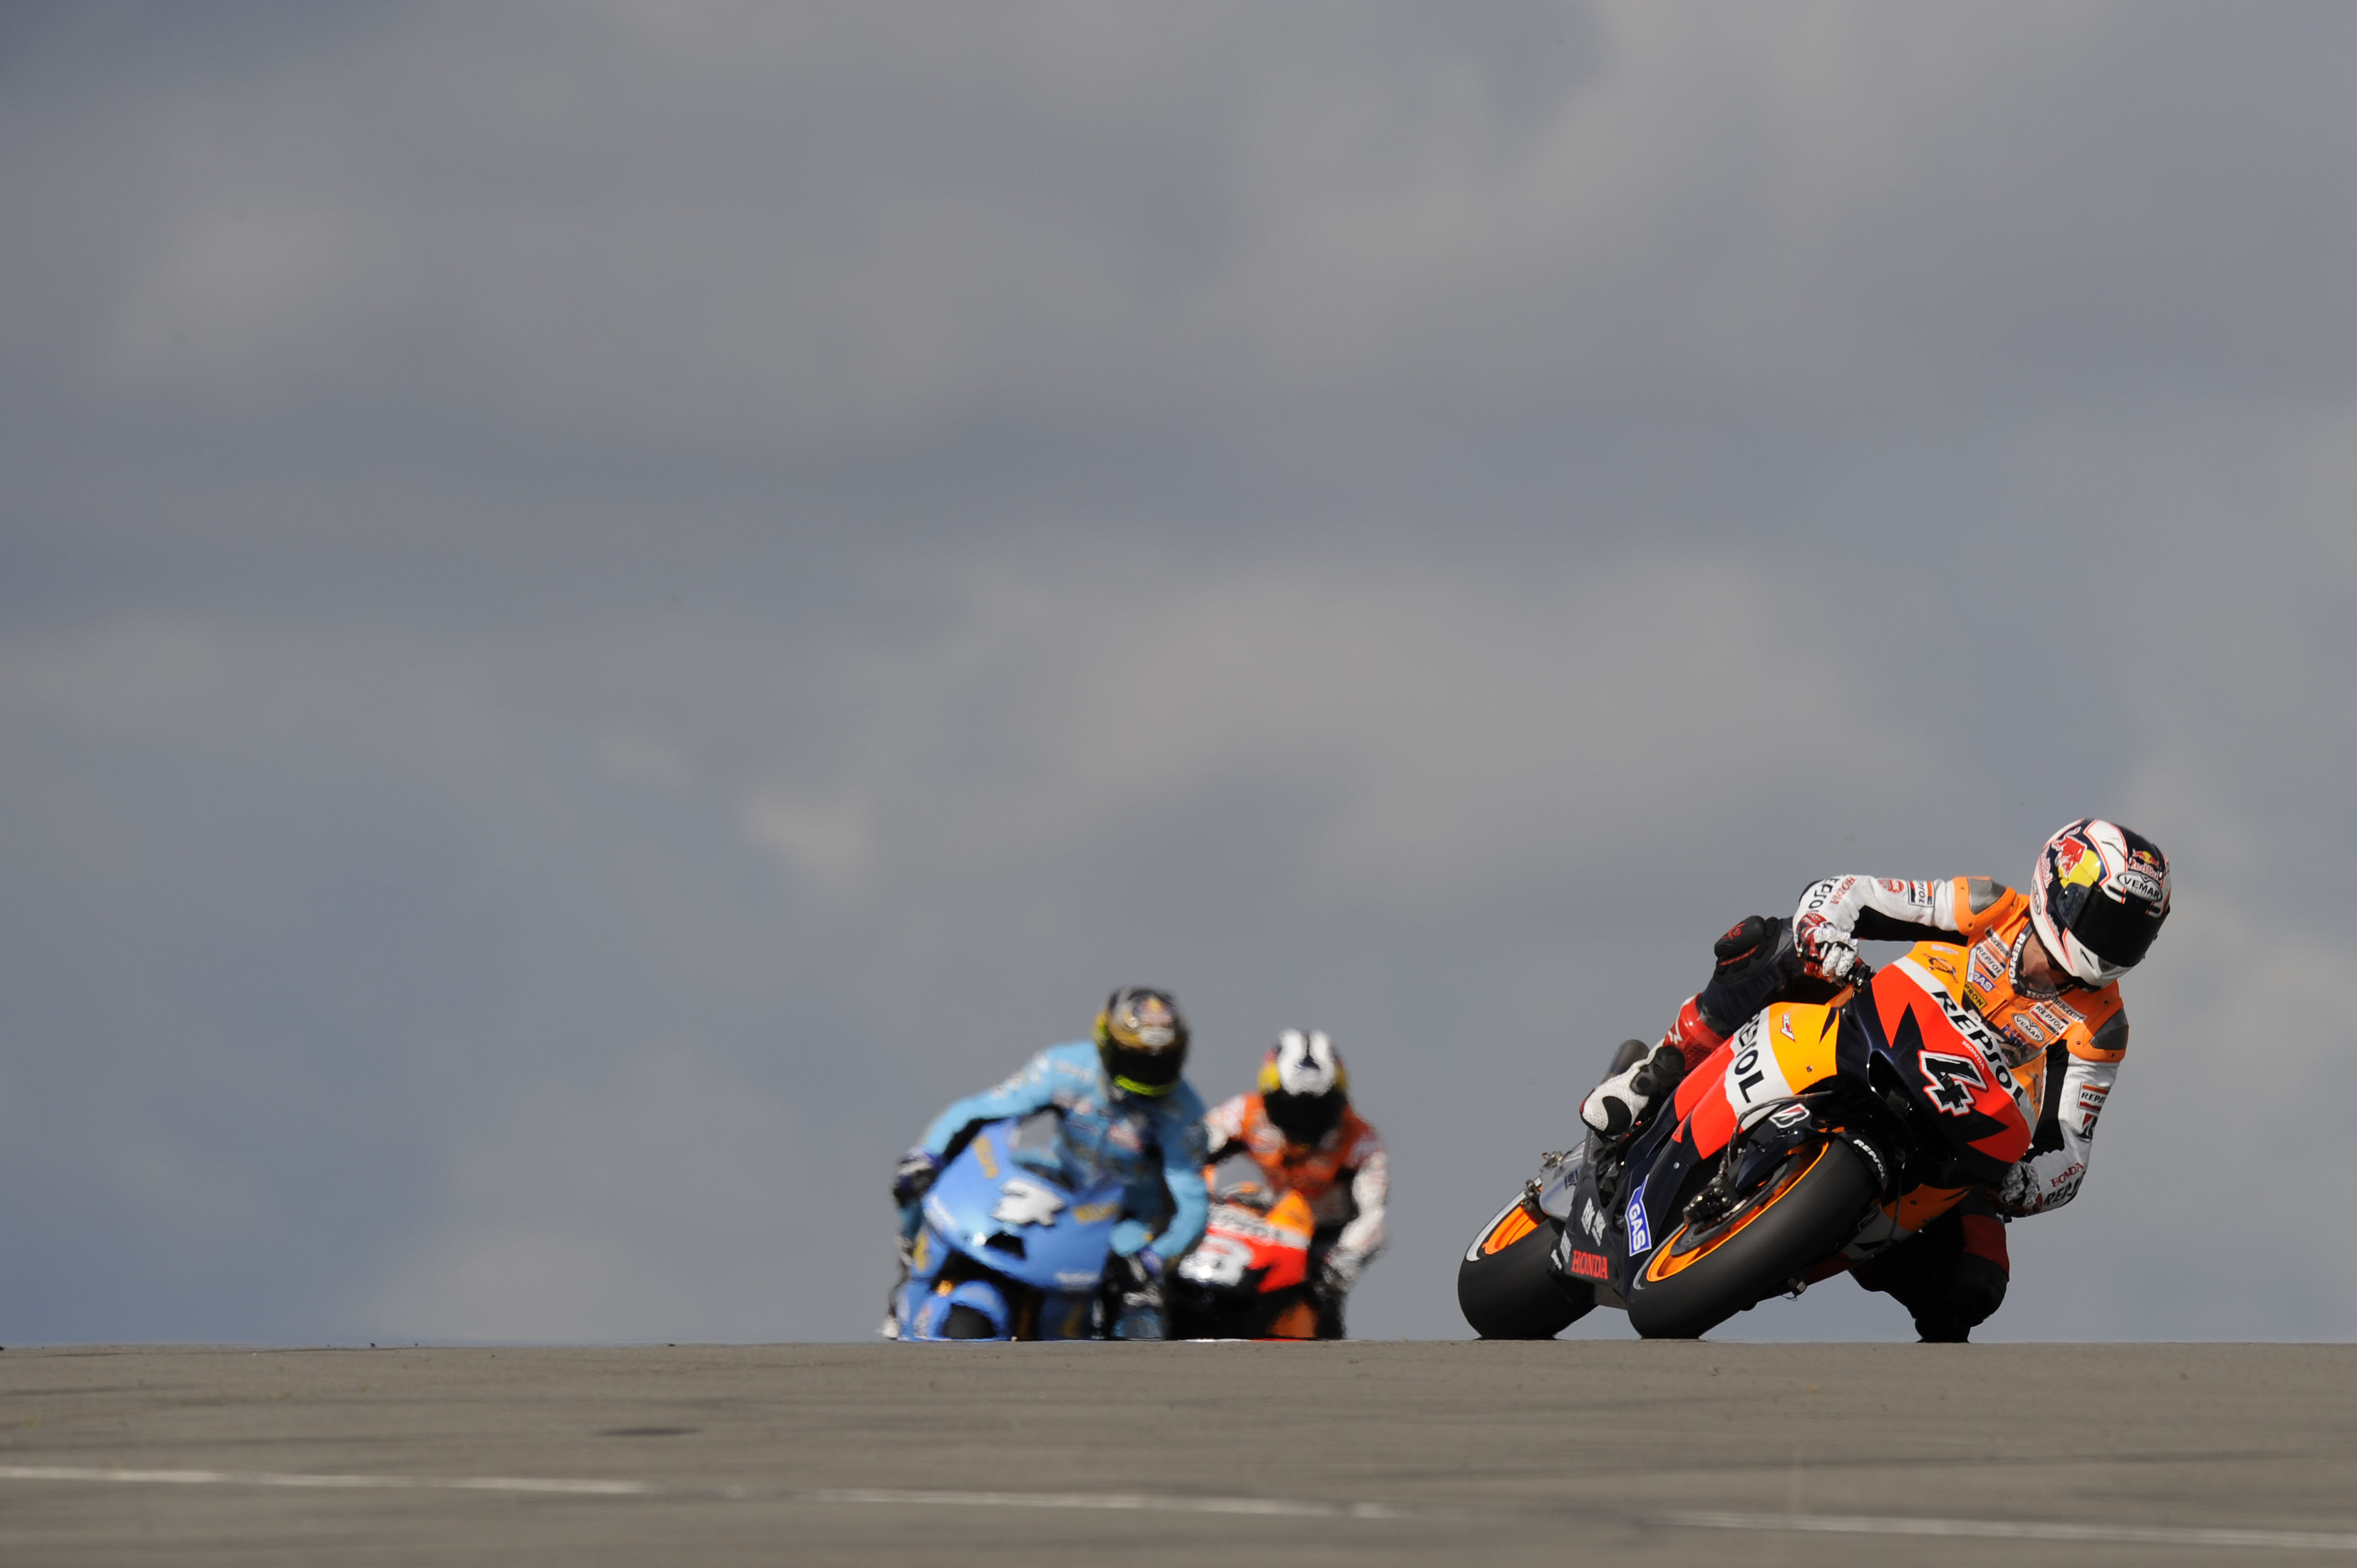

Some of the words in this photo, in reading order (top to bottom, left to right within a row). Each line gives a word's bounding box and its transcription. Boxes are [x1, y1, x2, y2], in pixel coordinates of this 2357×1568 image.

[2124, 875, 2161, 901] VEMAR
[1976, 946, 2002, 975] REPSOL
[2007, 933, 2026, 985] REPSOL
[2016, 1017, 2040, 1040] VEMAR
[2036, 1005, 2064, 1031] REPSOL
[1931, 991, 2024, 1108] REPSOL
[1961, 1039, 1984, 1071] HONDA
[1920, 1051, 1988, 1114] 4
[2050, 1162, 2085, 1188] HONDA
[1629, 1203, 1647, 1251] GAS
[1571, 1249, 1609, 1280] HONDA
